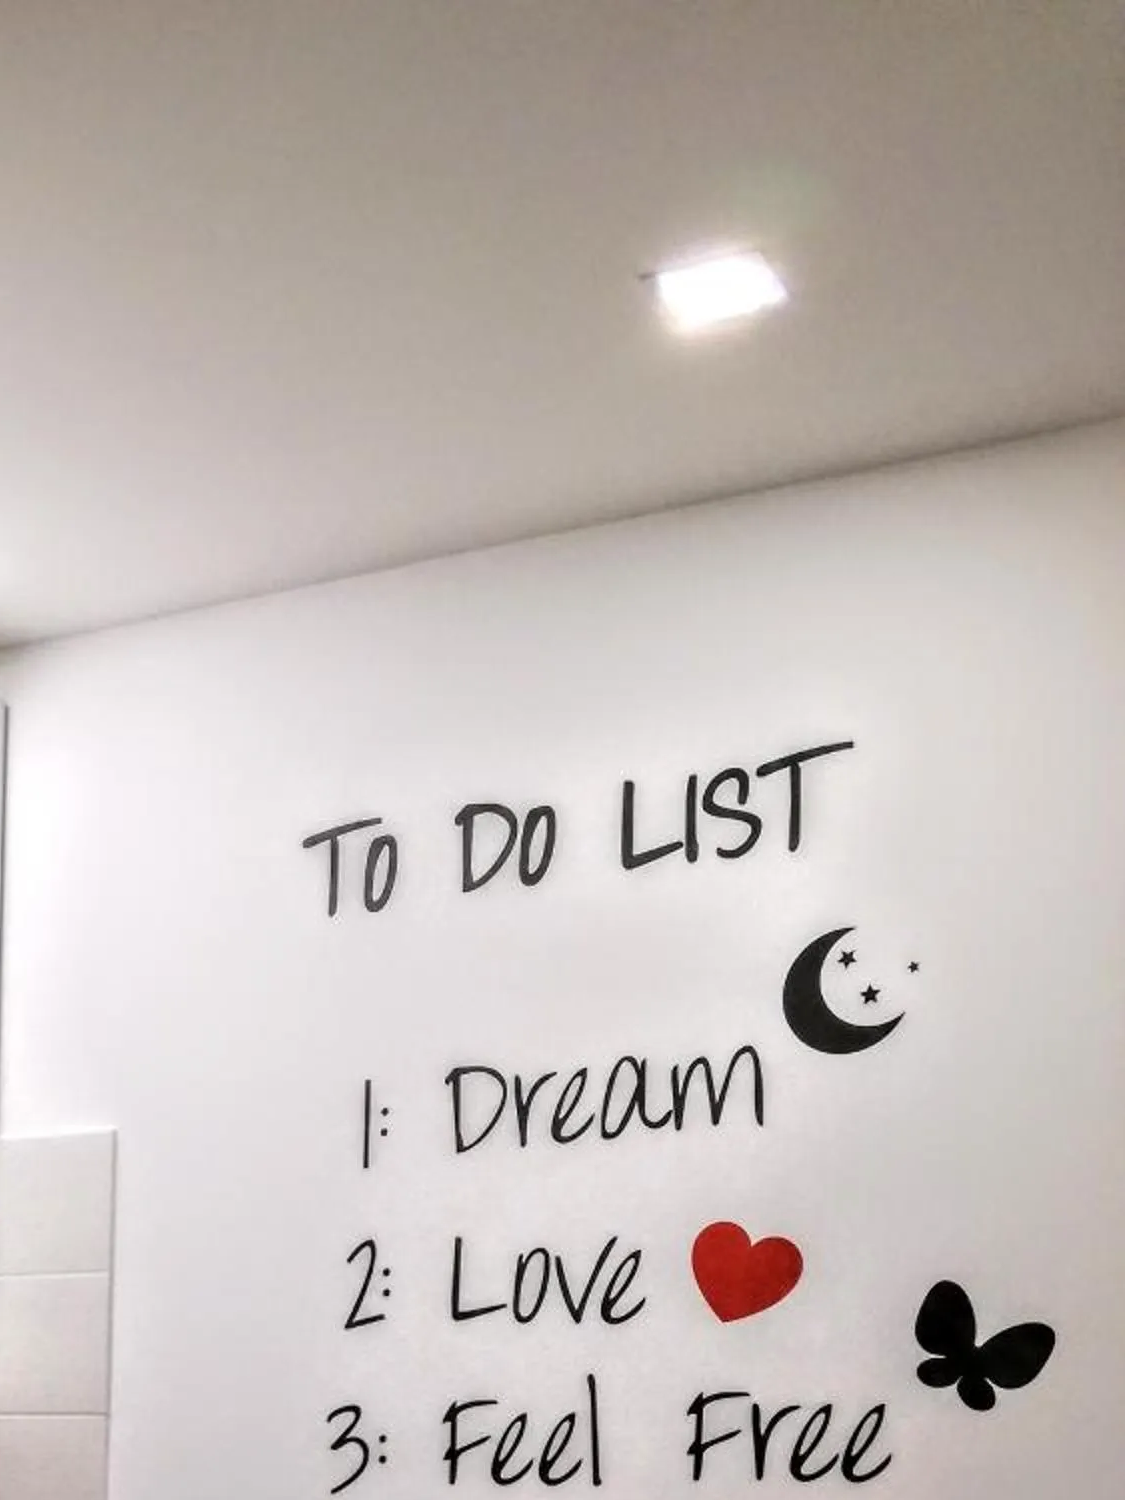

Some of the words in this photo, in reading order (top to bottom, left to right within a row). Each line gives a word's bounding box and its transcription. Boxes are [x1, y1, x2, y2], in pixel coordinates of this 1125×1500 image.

[454, 802, 557, 893] DO
[621, 741, 855, 870] LIST
[444, 1045, 765, 1154] Dream
[344, 1238, 393, 1330] 2:
[450, 1236, 646, 1325] Love
[325, 1404, 388, 1495] 3:
[442, 1373, 603, 1487] Feel
[686, 1391, 893, 1484] Free
